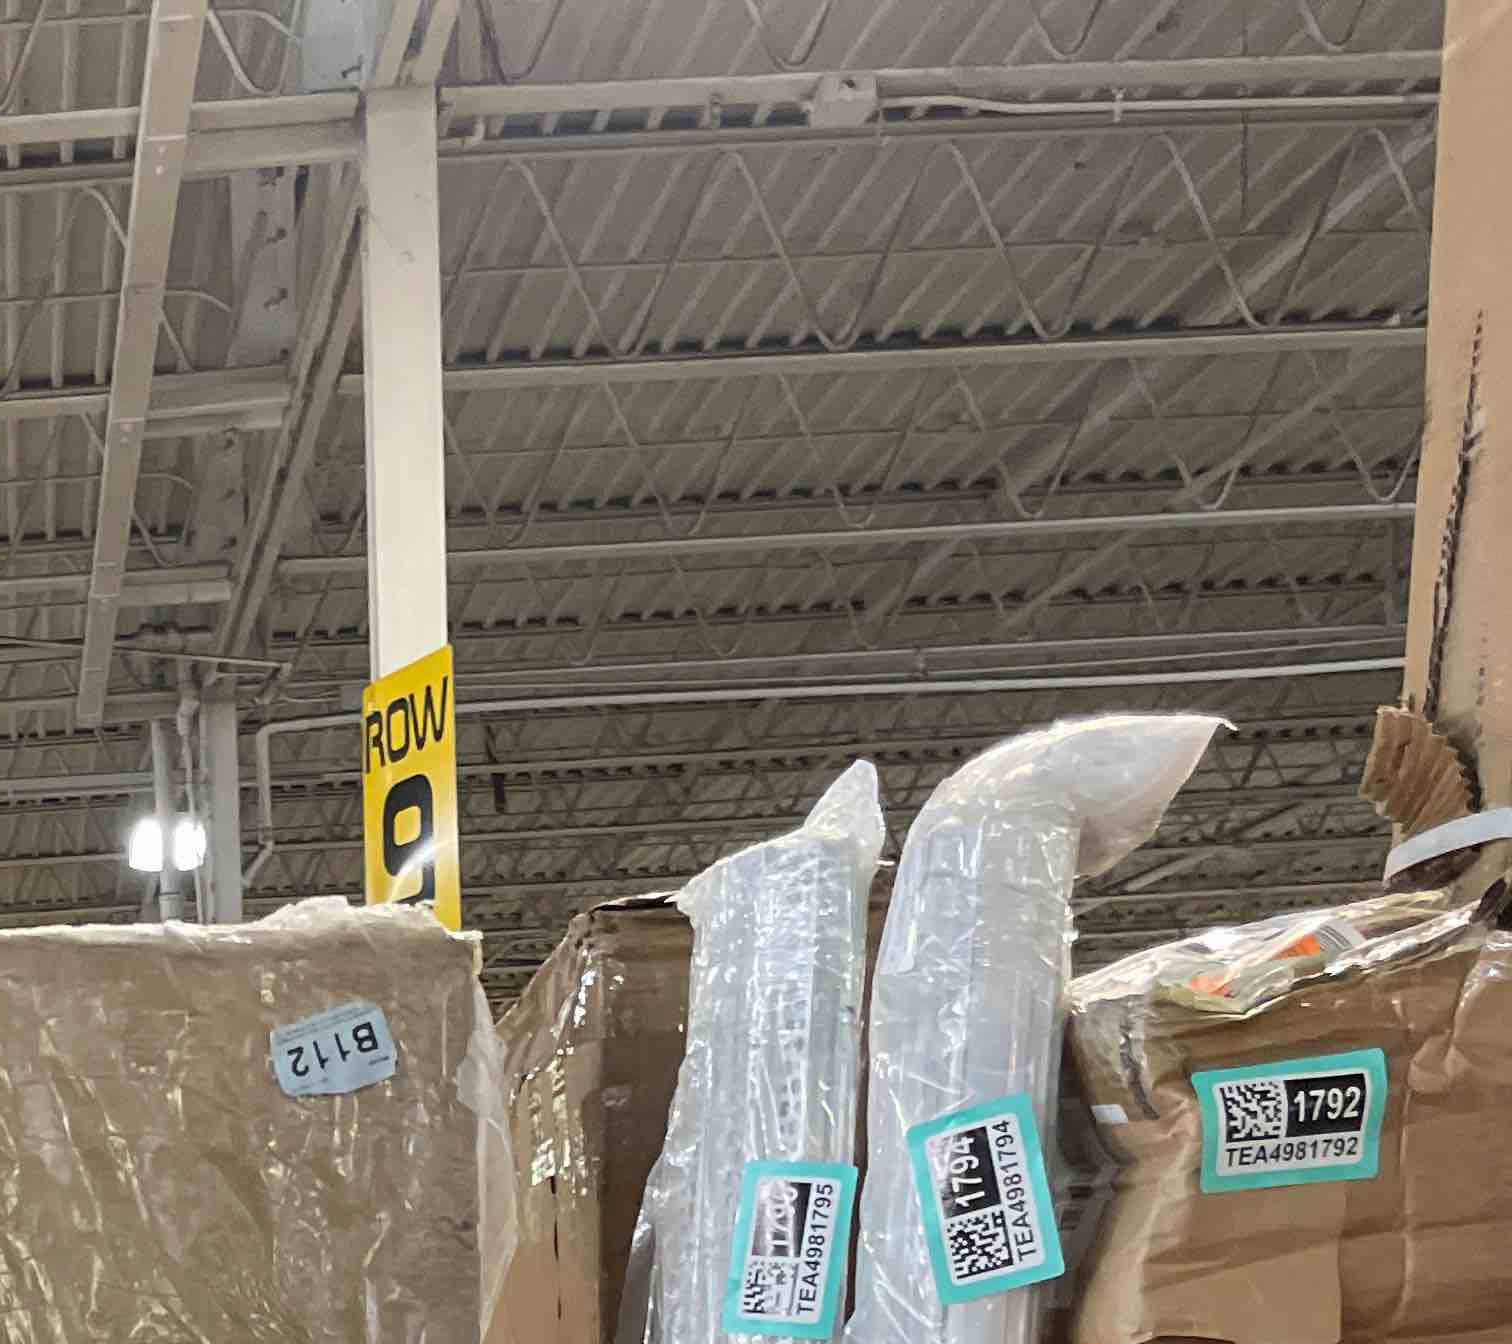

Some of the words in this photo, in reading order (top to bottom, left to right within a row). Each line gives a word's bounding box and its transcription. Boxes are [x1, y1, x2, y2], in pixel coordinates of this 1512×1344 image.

[365, 676, 448, 773] ROW
[288, 1021, 378, 1076] B112
[1294, 1086, 1361, 1122] 1792
[951, 1136, 986, 1208] 1794
[1225, 1136, 1358, 1167] TEA4981792
[992, 1120, 1037, 1262] TEA4981794
[796, 1183, 834, 1315] TEA4981795
